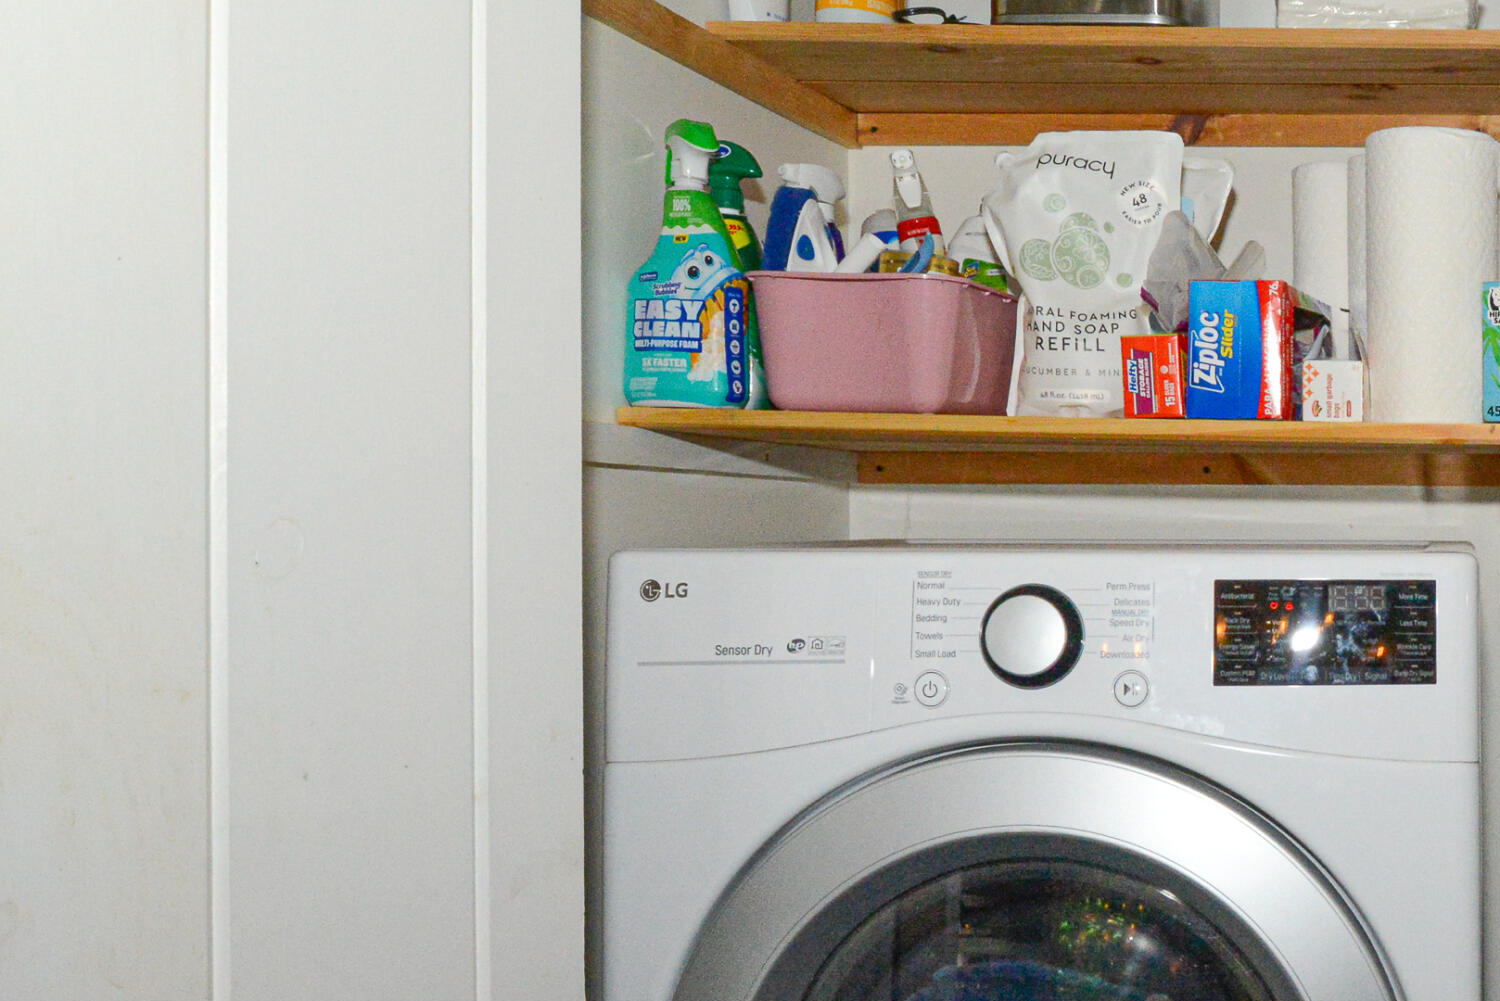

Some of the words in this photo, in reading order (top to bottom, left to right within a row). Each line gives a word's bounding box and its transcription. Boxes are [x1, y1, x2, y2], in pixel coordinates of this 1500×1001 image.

[1036, 153, 1115, 179] puracy
[1132, 193, 1147, 207] 48
[653, 282, 682, 291] Scrubbing
[655, 288, 677, 296] Bubbles
[635, 300, 704, 320] EASY
[1070, 309, 1137, 321] FOAMING
[634, 320, 701, 338] CLEAN
[1074, 323, 1120, 335] SOAP
[1221, 309, 1234, 358] Slider
[1193, 312, 1225, 385] Ziploc
[1099, 368, 1121, 377] MIN
[1128, 361, 1138, 391] Hefty
[1138, 358, 1146, 397] STORAGE
[1165, 397, 1176, 406] 15
[665, 582, 688, 598] LG
[1129, 582, 1150, 591] Press
[917, 598, 940, 606] Heavy
[943, 598, 961, 606] Duty
[1113, 598, 1150, 606] Delicates
[916, 615, 947, 623] Bedding
[915, 632, 943, 640] Towels
[715, 645, 752, 656] Sensor
[754, 644, 773, 658] Dry
[915, 650, 935, 658] Small
[937, 650, 956, 658] Load
